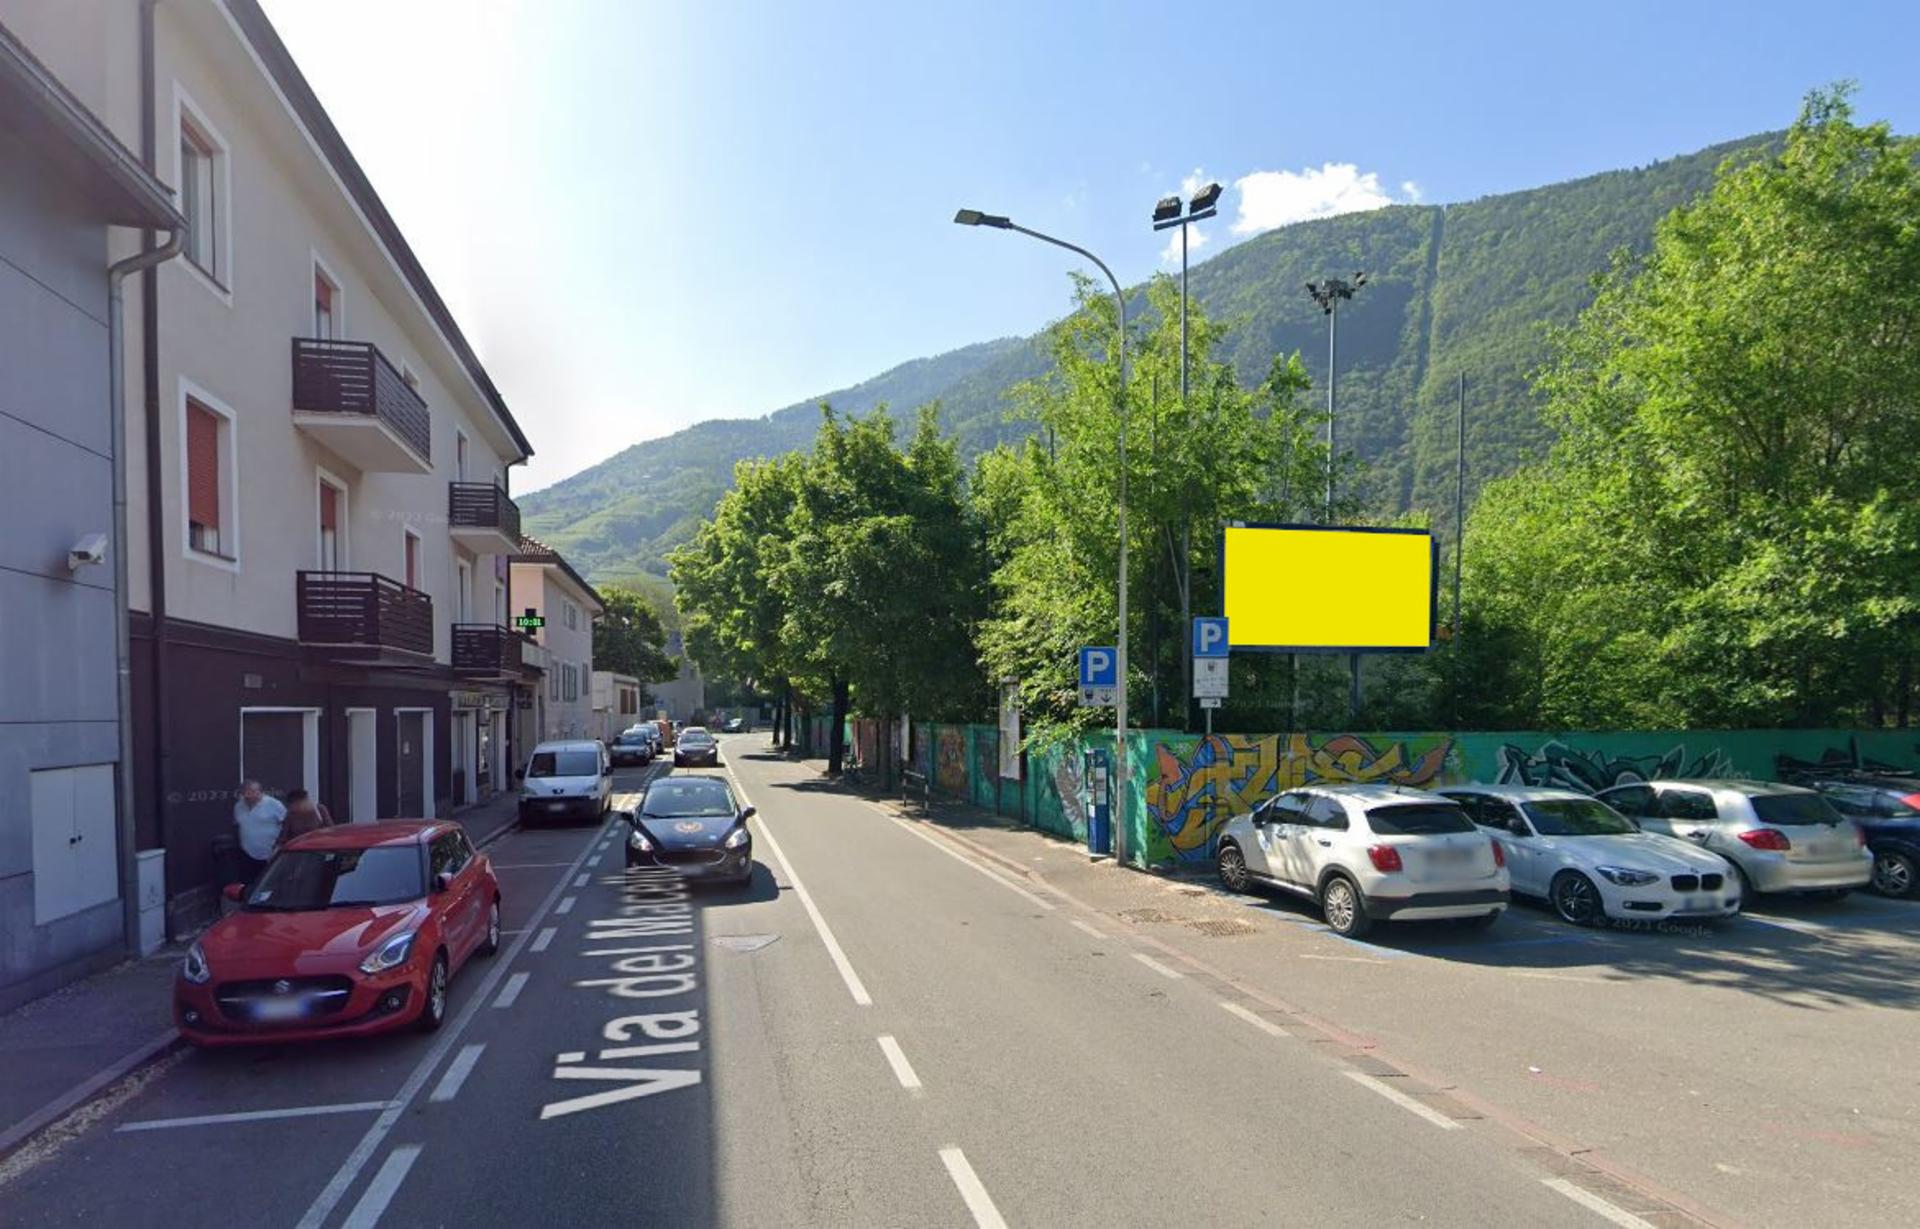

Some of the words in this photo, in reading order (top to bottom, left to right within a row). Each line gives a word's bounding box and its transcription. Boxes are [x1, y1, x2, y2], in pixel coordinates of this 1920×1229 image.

[1201, 623, 1221, 652] P
[1087, 651, 1110, 682] P
[573, 944, 697, 998] del
[540, 1010, 702, 1120] Via
